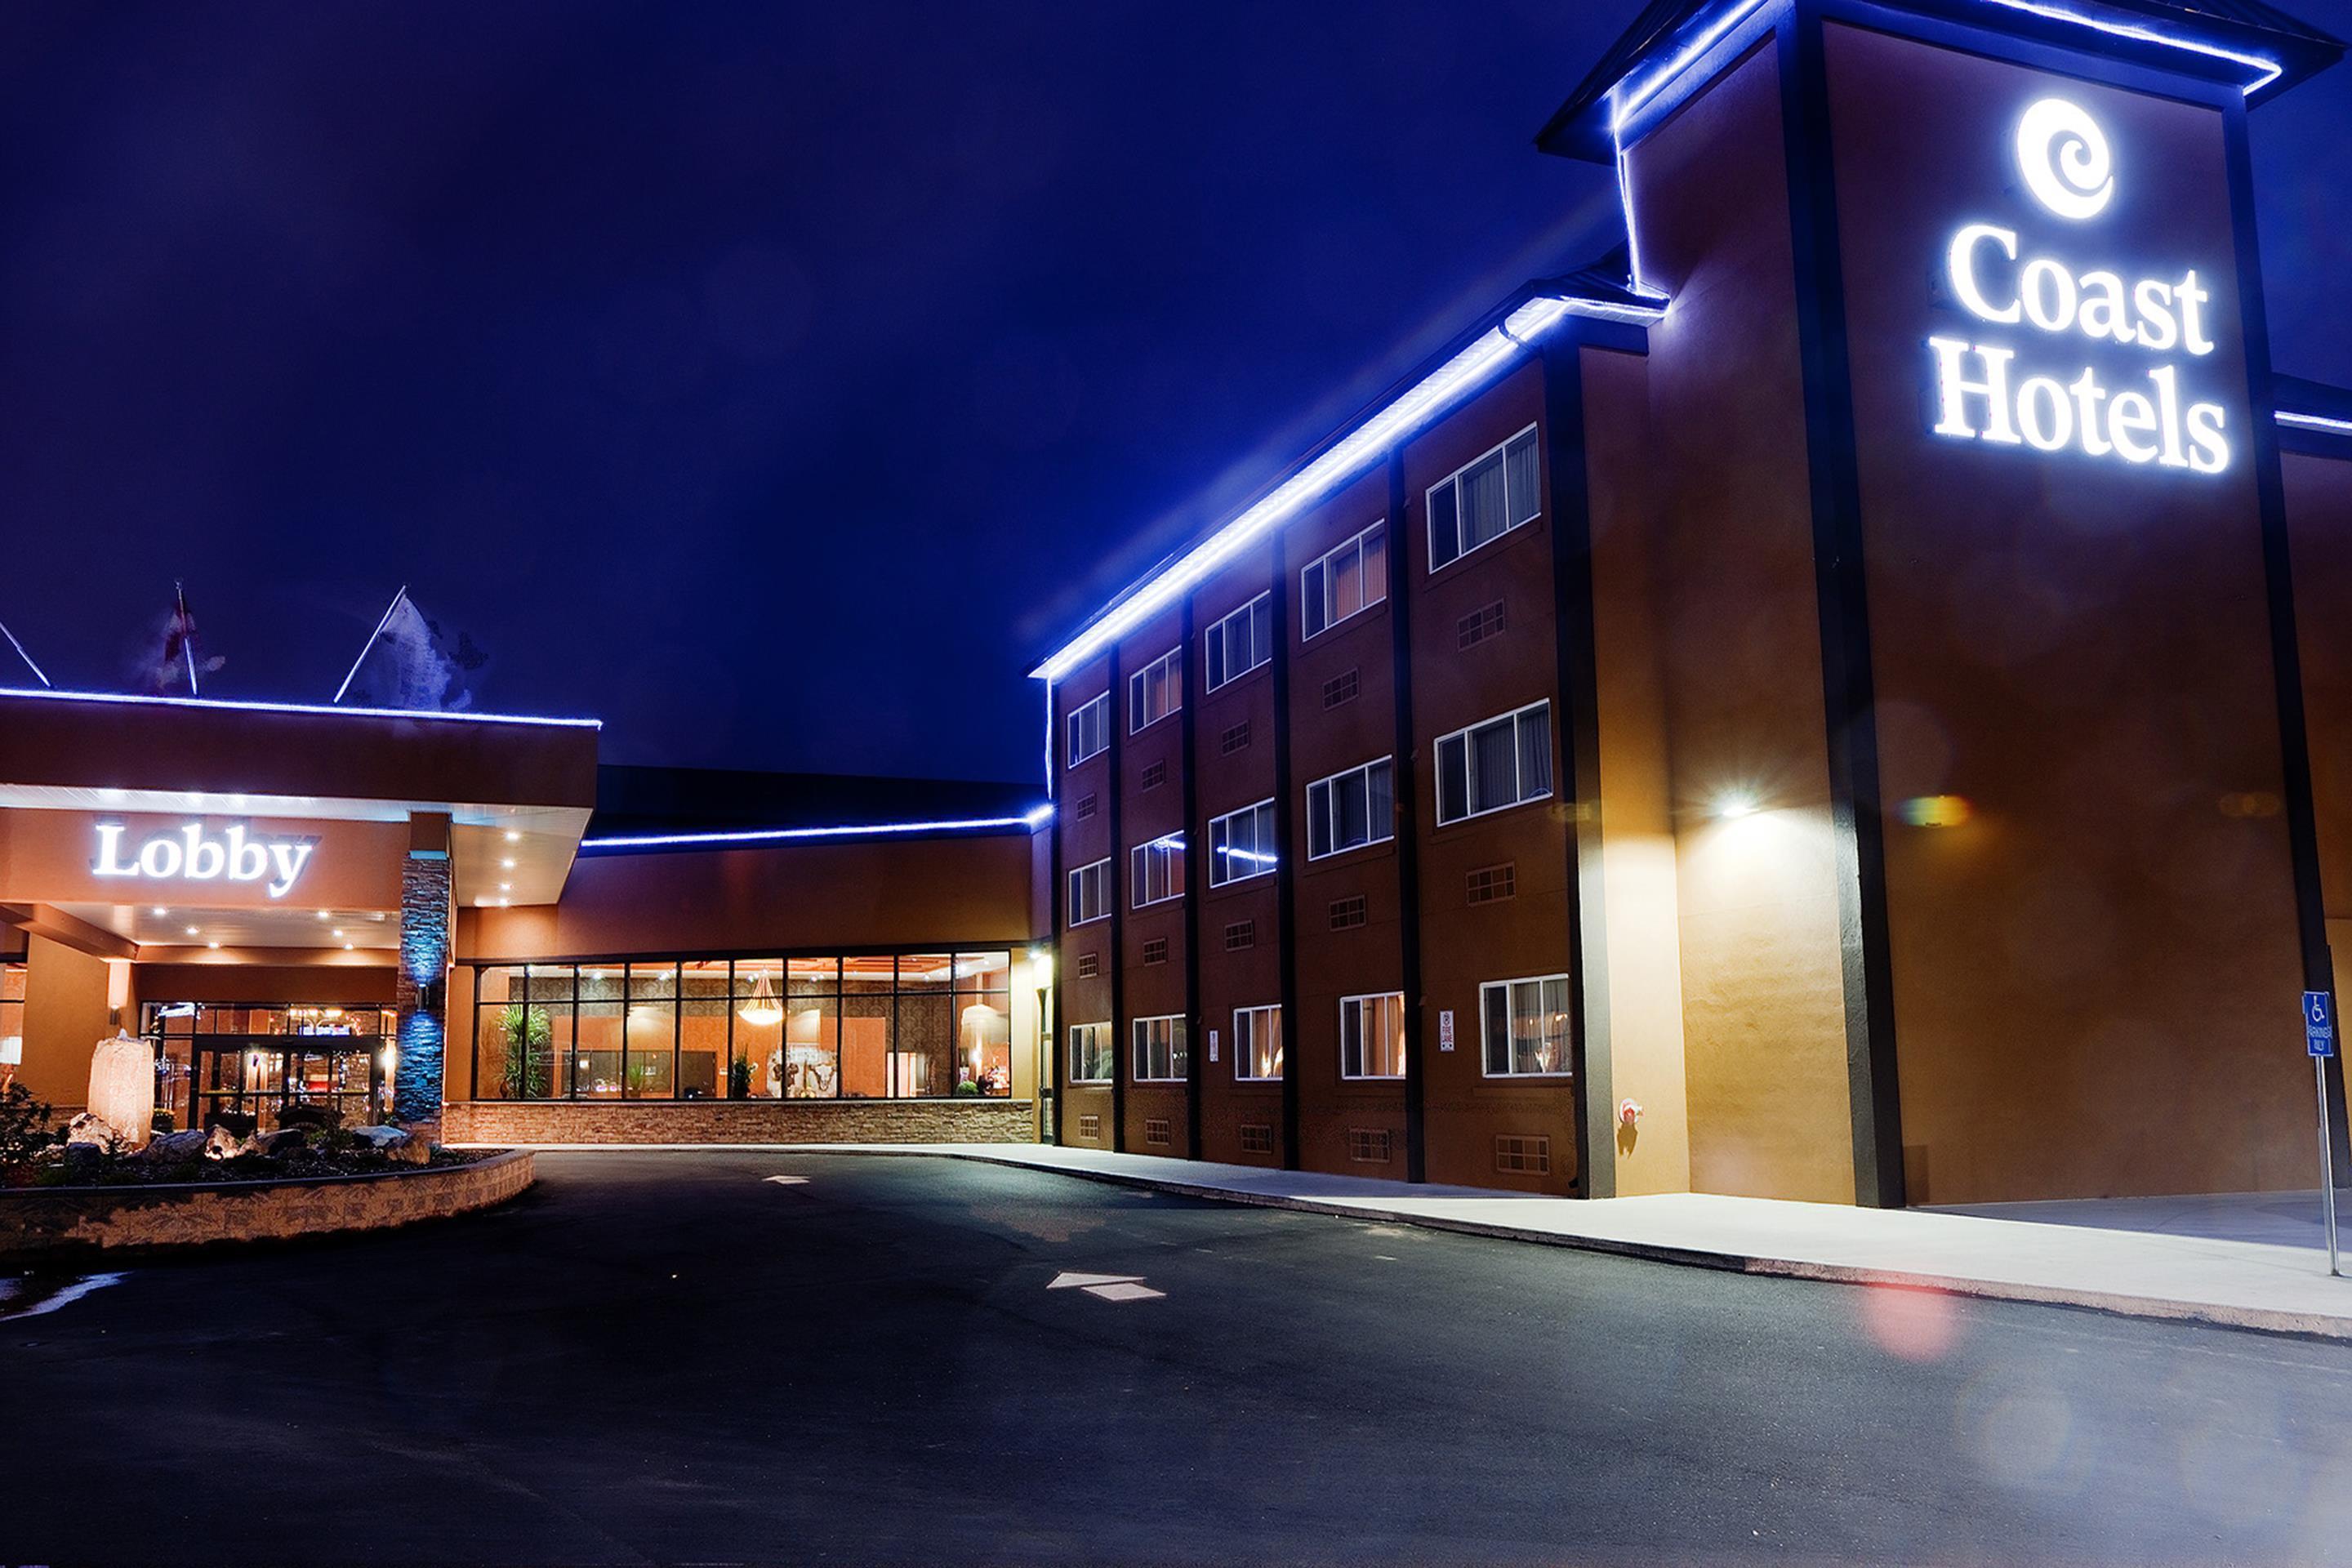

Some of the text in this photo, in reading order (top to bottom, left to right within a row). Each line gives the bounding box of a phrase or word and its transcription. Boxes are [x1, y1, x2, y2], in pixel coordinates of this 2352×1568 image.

[1949, 225, 2214, 355] Coast
[1929, 336, 2230, 474] Hotels
[92, 822, 314, 898] Lobby
